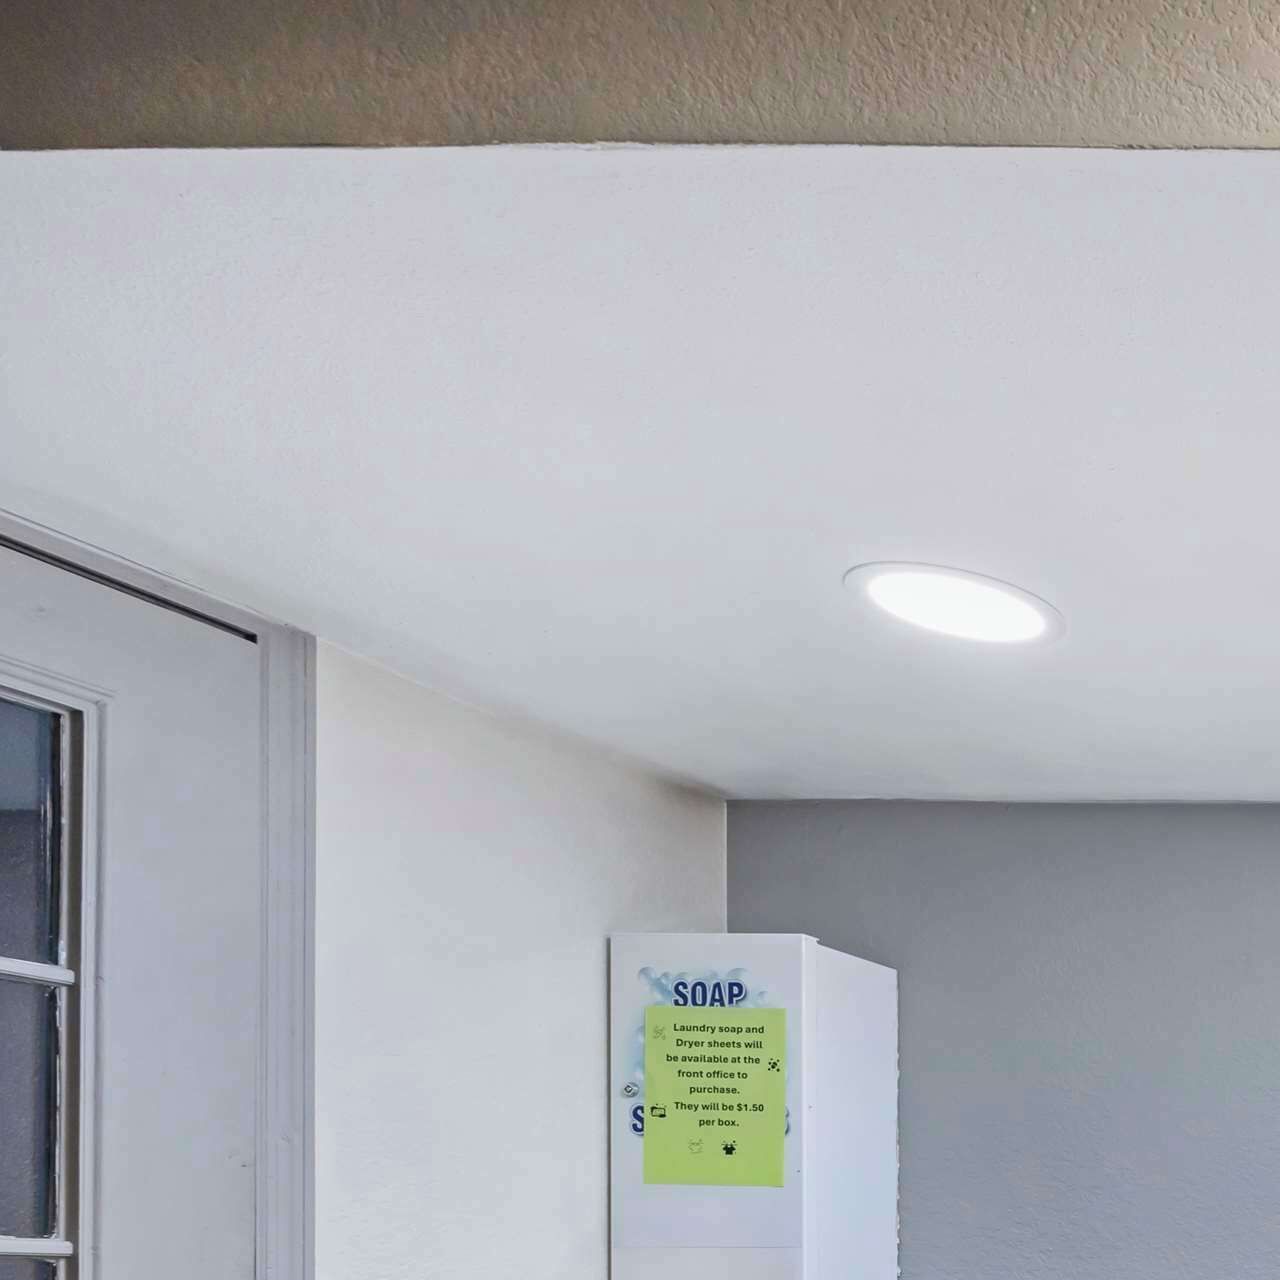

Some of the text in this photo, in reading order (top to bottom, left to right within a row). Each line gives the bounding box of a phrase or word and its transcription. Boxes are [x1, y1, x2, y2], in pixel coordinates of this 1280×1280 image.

[673, 981, 744, 1007] SOAP
[673, 1023, 765, 1035] Laundry soap and
[675, 1039, 763, 1049] Dryer sheets will
[666, 1054, 761, 1064] be available at the
[677, 1069, 748, 1079] front office to
[689, 1085, 740, 1094] purchase.
[674, 1101, 764, 1112] They will be $1.50
[698, 1118, 740, 1128] per box.
